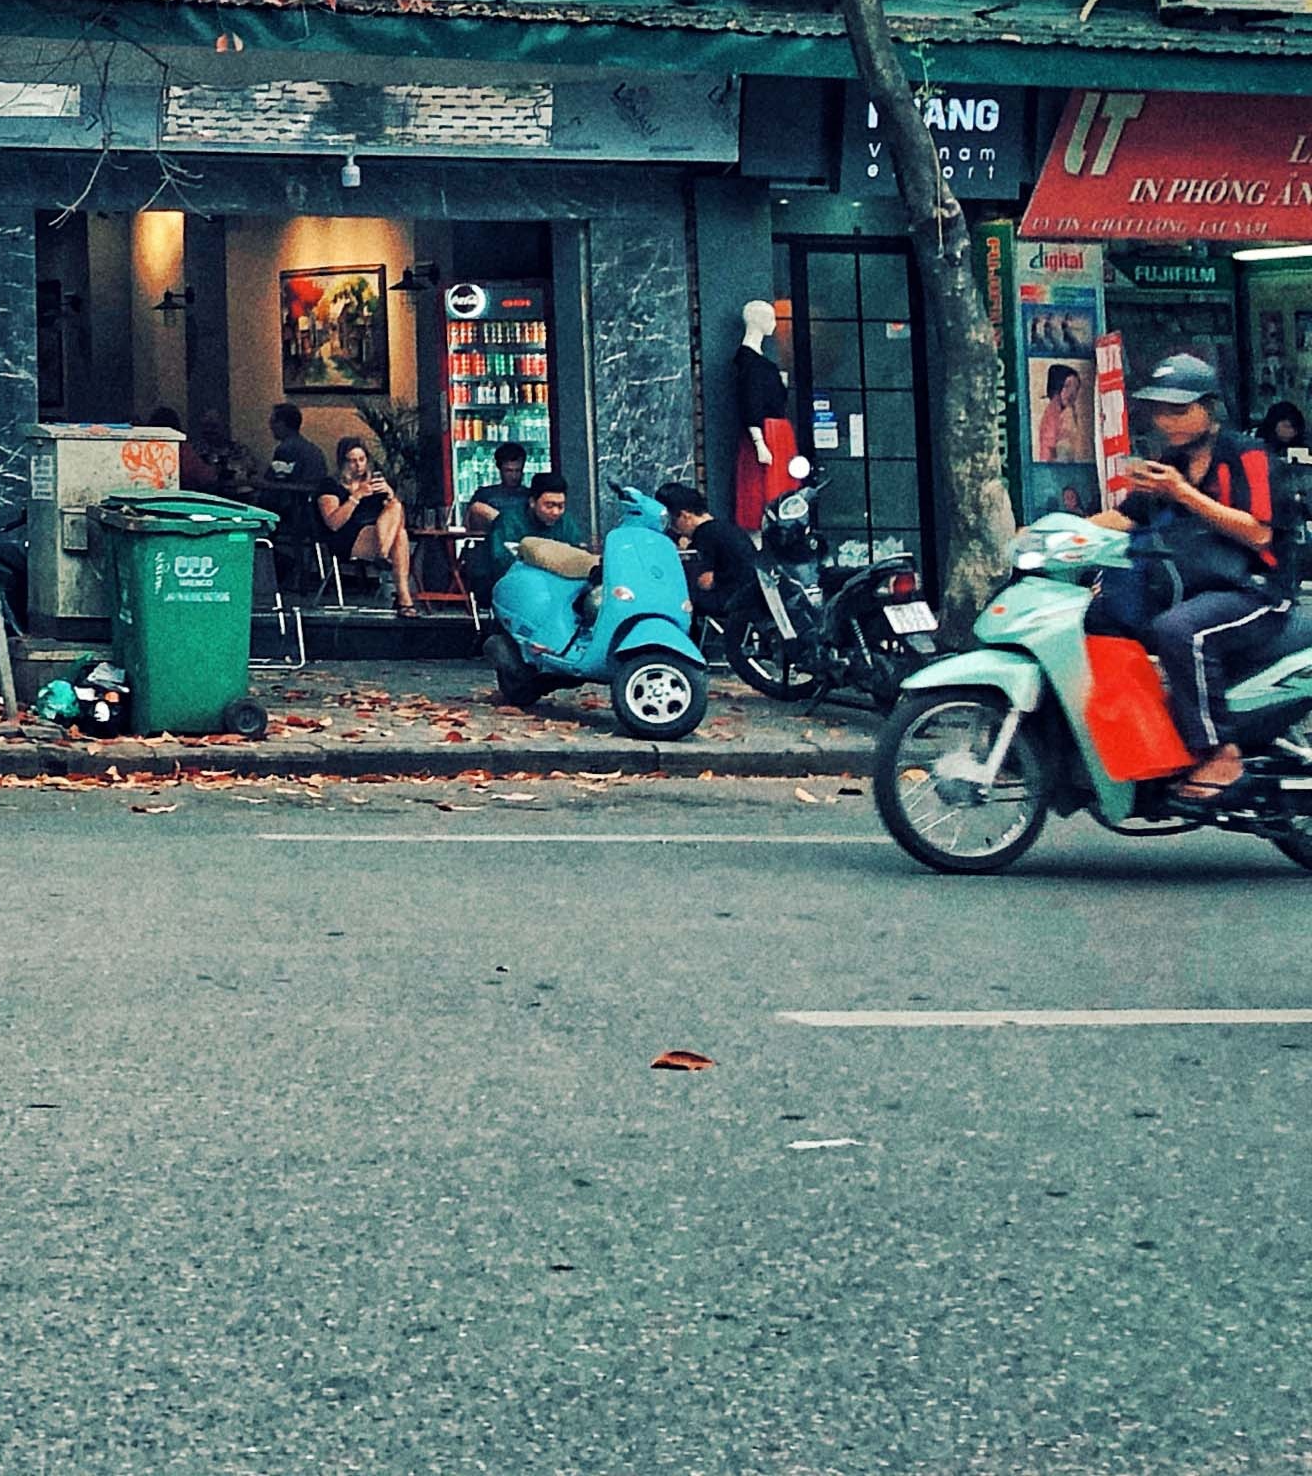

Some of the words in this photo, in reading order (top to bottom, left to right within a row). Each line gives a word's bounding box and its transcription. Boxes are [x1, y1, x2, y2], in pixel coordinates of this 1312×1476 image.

[868, 142, 996, 161] Vnam
[1128, 178, 1163, 204] IN
[1164, 171, 1271, 206] PHÓNG
[1029, 243, 1084, 272] digital
[1134, 265, 1217, 283] FUJIFILM
